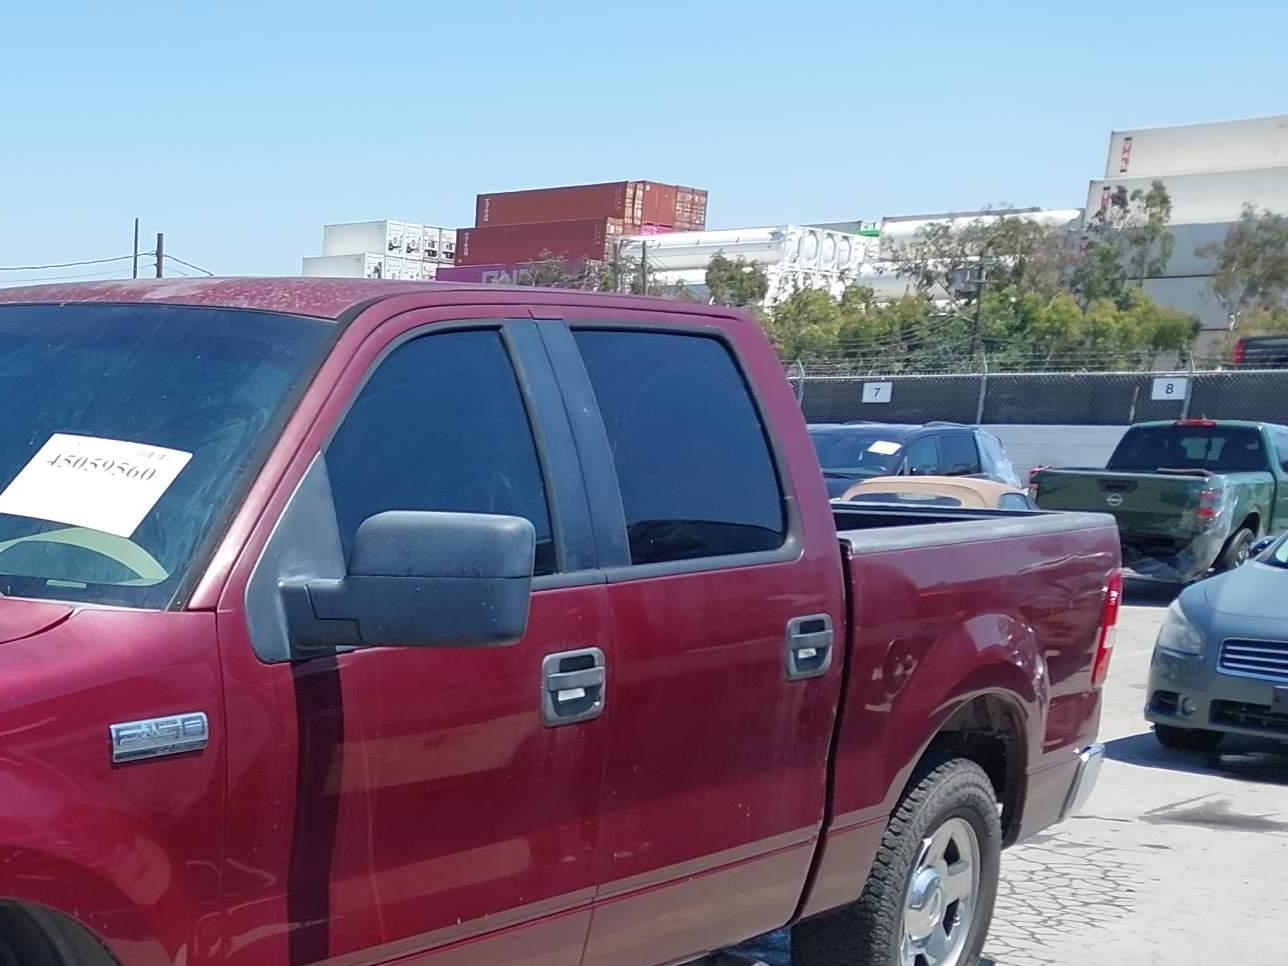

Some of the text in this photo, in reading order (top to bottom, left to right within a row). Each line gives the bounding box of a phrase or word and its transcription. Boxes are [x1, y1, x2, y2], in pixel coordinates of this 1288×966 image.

[873, 387, 881, 398] 7
[1165, 383, 1174, 395] 8
[46, 453, 158, 481] 45059560
